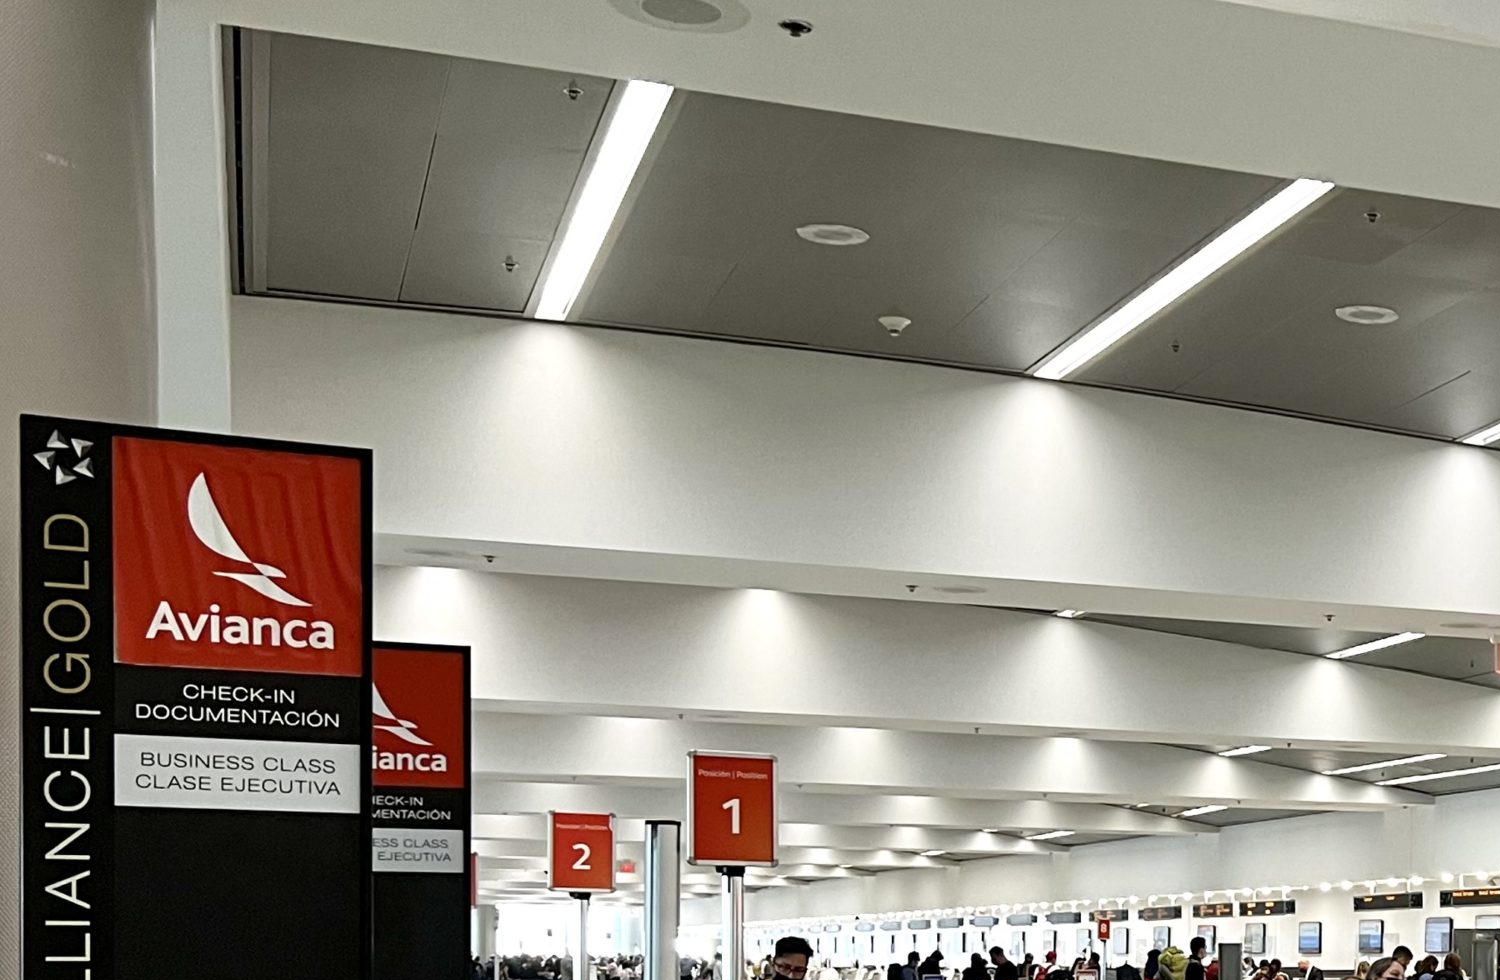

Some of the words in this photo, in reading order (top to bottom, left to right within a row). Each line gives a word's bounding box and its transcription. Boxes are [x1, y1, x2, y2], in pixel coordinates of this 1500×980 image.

[145, 601, 335, 650] Avianca
[182, 684, 295, 705] CHECK-IN
[135, 703, 340, 728] DOCUMENTACIÓN
[140, 752, 255, 771] BUSINESS
[263, 757, 336, 774] CLASS
[372, 745, 448, 772] ianca
[135, 774, 212, 791] CLASE
[221, 777, 341, 796] EJECUTIVA
[722, 798, 740, 834] 1
[403, 838, 449, 849] CLASS
[378, 852, 452, 862] EJECUTIVA
[572, 843, 591, 870] 2
